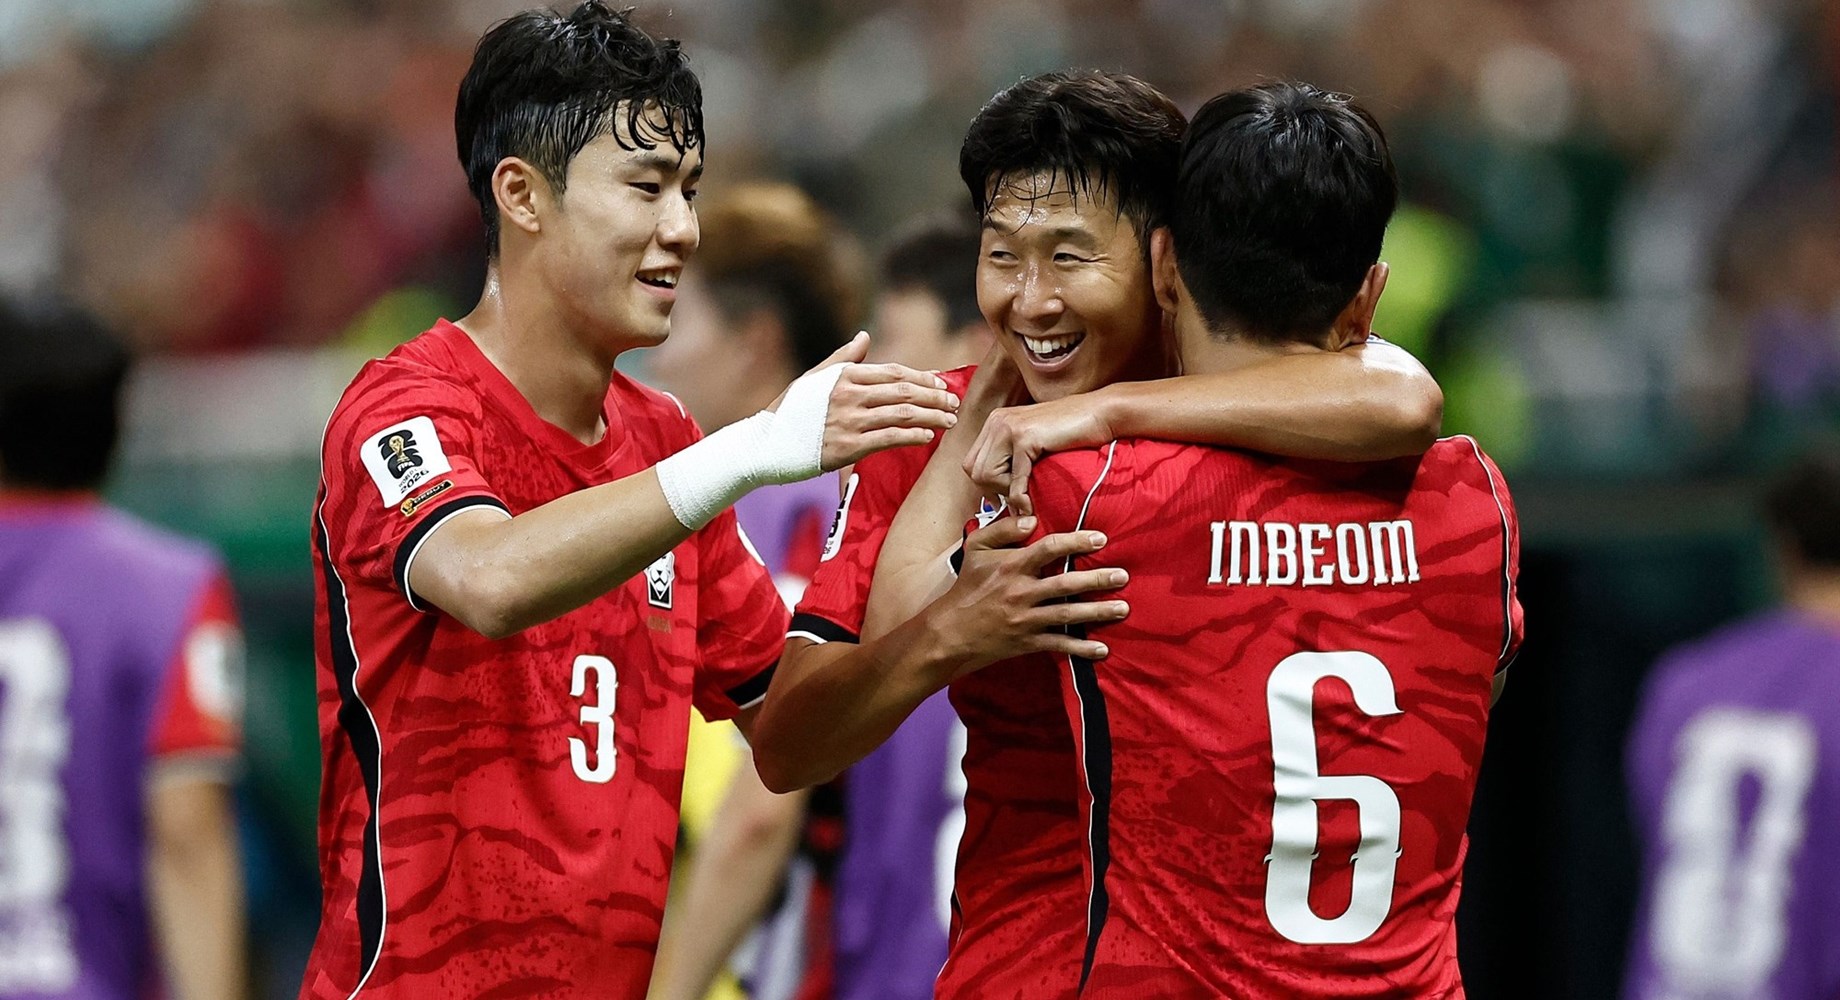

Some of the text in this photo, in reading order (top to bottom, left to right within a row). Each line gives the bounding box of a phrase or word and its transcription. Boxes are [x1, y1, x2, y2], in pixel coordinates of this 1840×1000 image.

[400, 470, 430, 494] 2026
[1206, 519, 1421, 588] INBEOM
[567, 654, 619, 784] 3
[1263, 650, 1405, 945] 6
